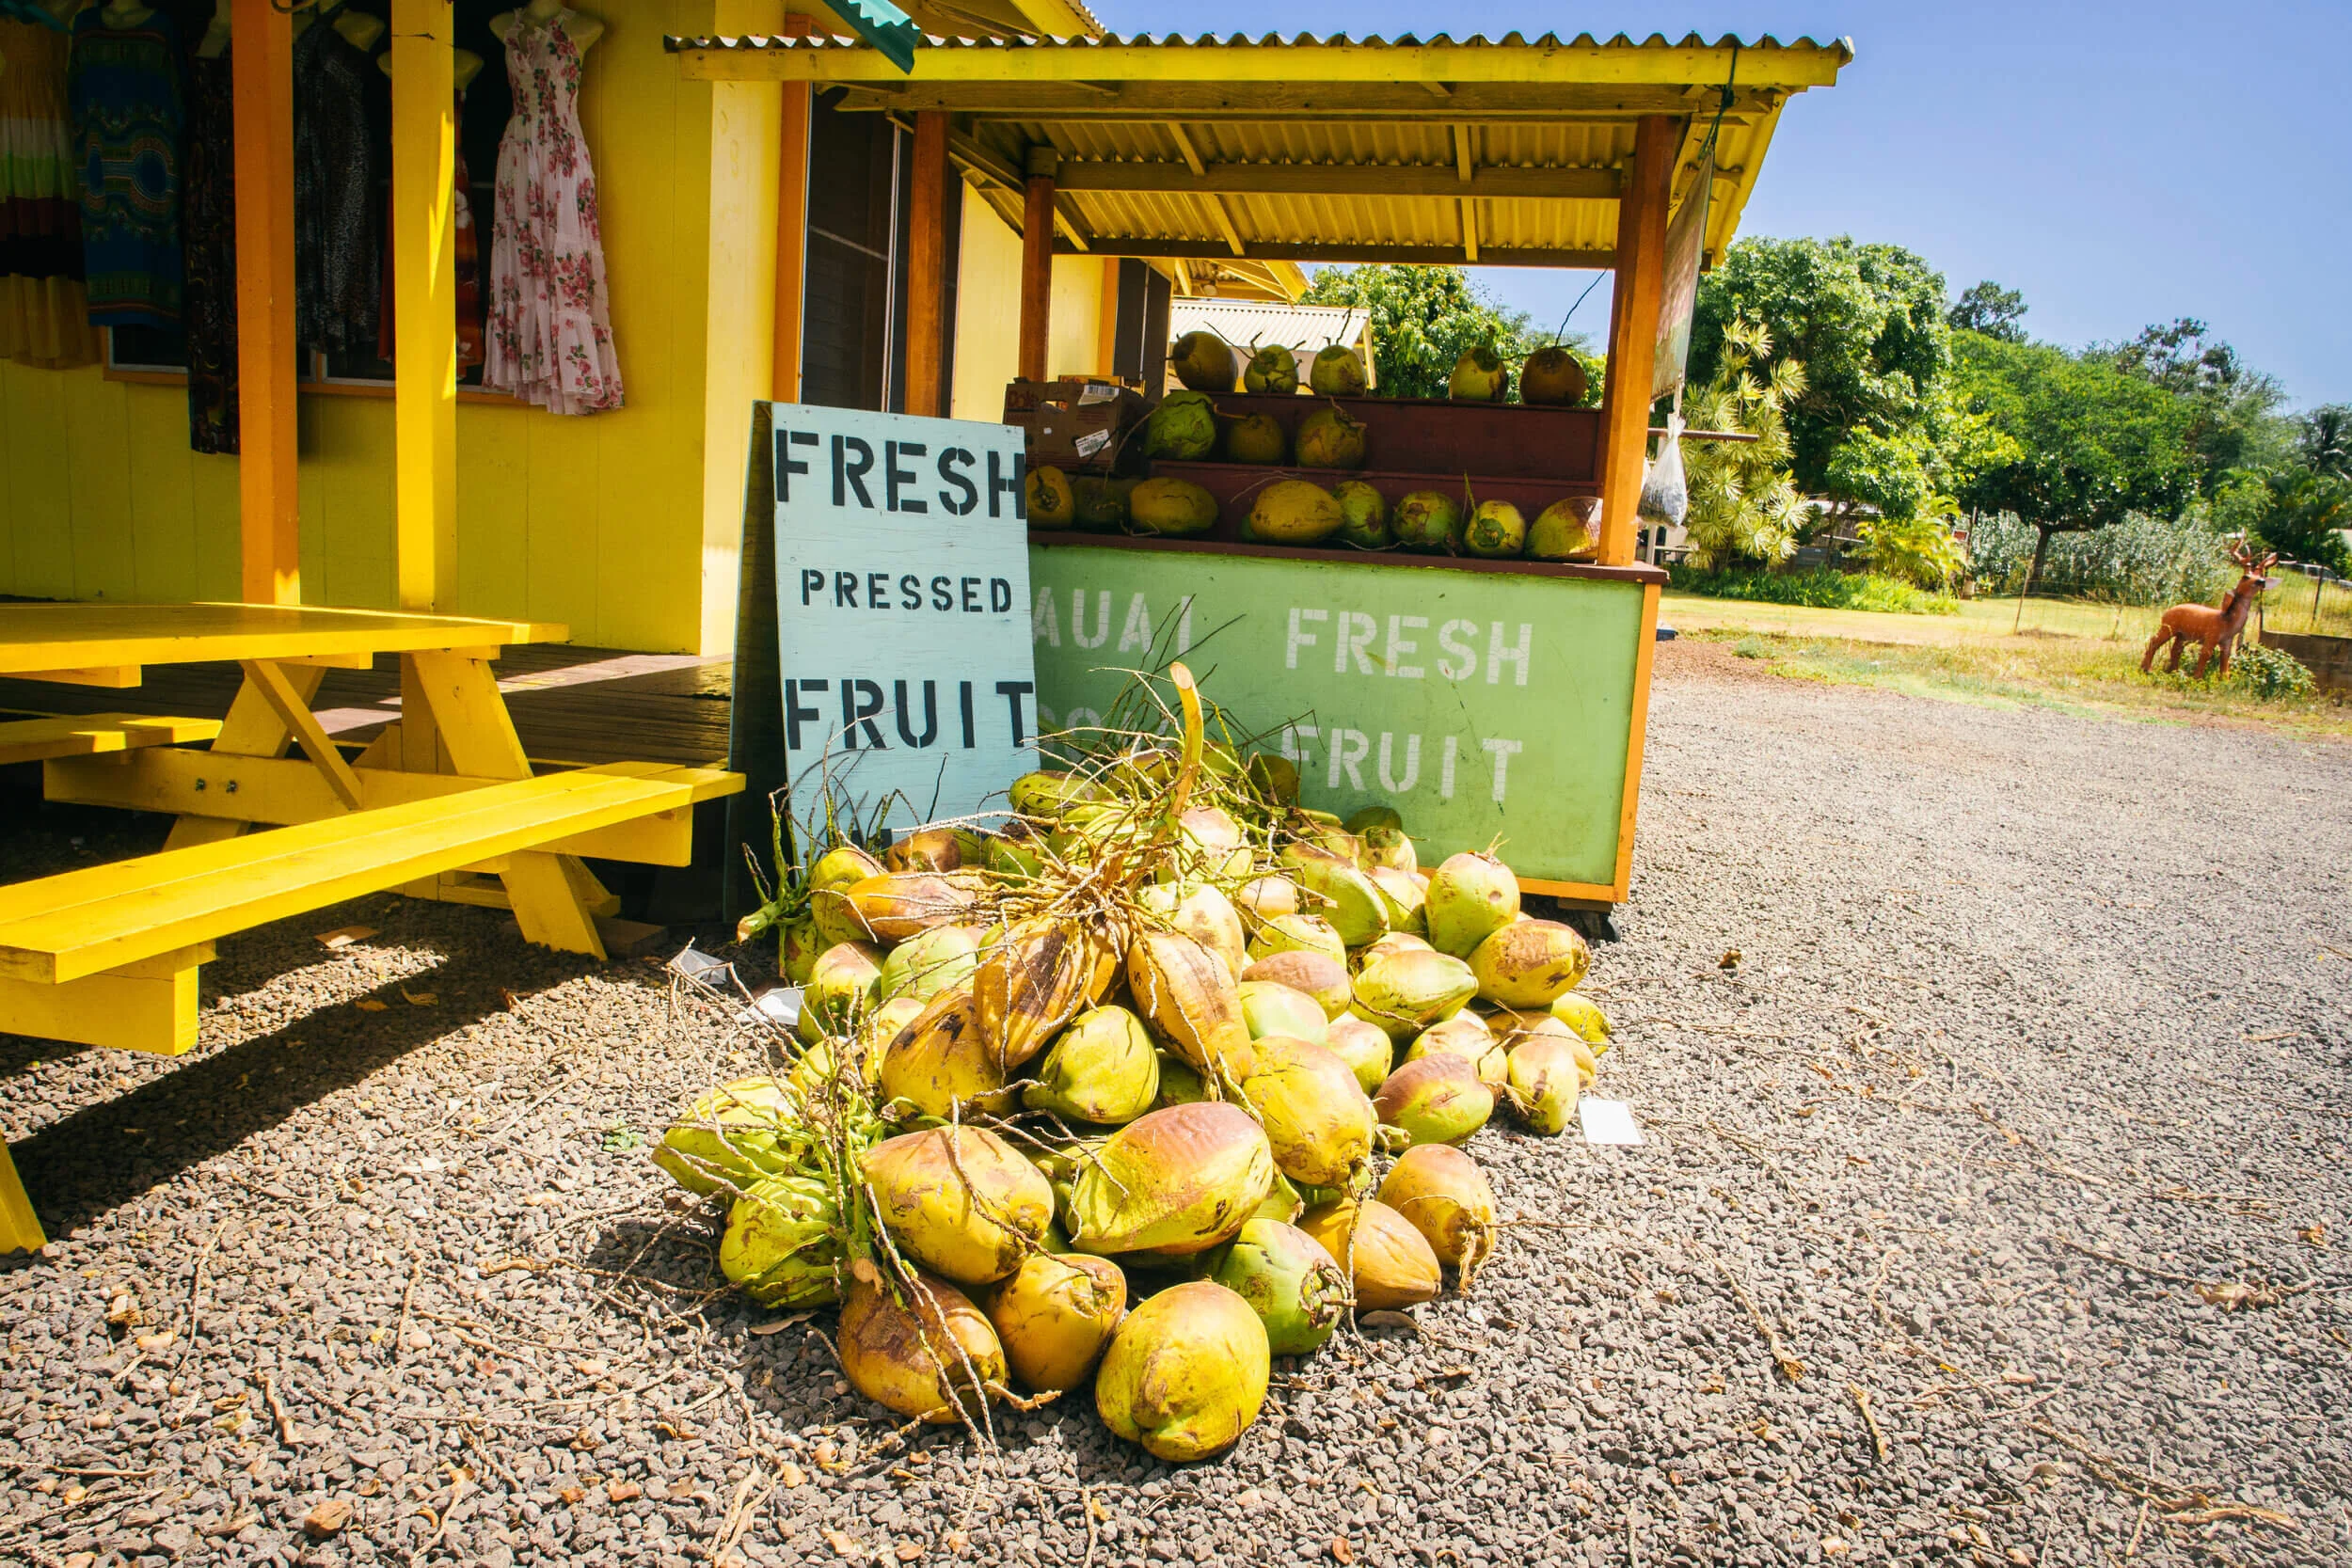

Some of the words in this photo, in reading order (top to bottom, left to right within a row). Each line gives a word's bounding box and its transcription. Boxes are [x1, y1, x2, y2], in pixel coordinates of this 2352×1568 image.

[775, 429, 1026, 519] FRESH
[802, 569, 1011, 612] PRESSED
[1032, 586, 1193, 657] AUAI
[1285, 607, 1533, 686] FRESH
[786, 679, 1034, 750] FRUIT
[1279, 724, 1523, 803] FRUIT
